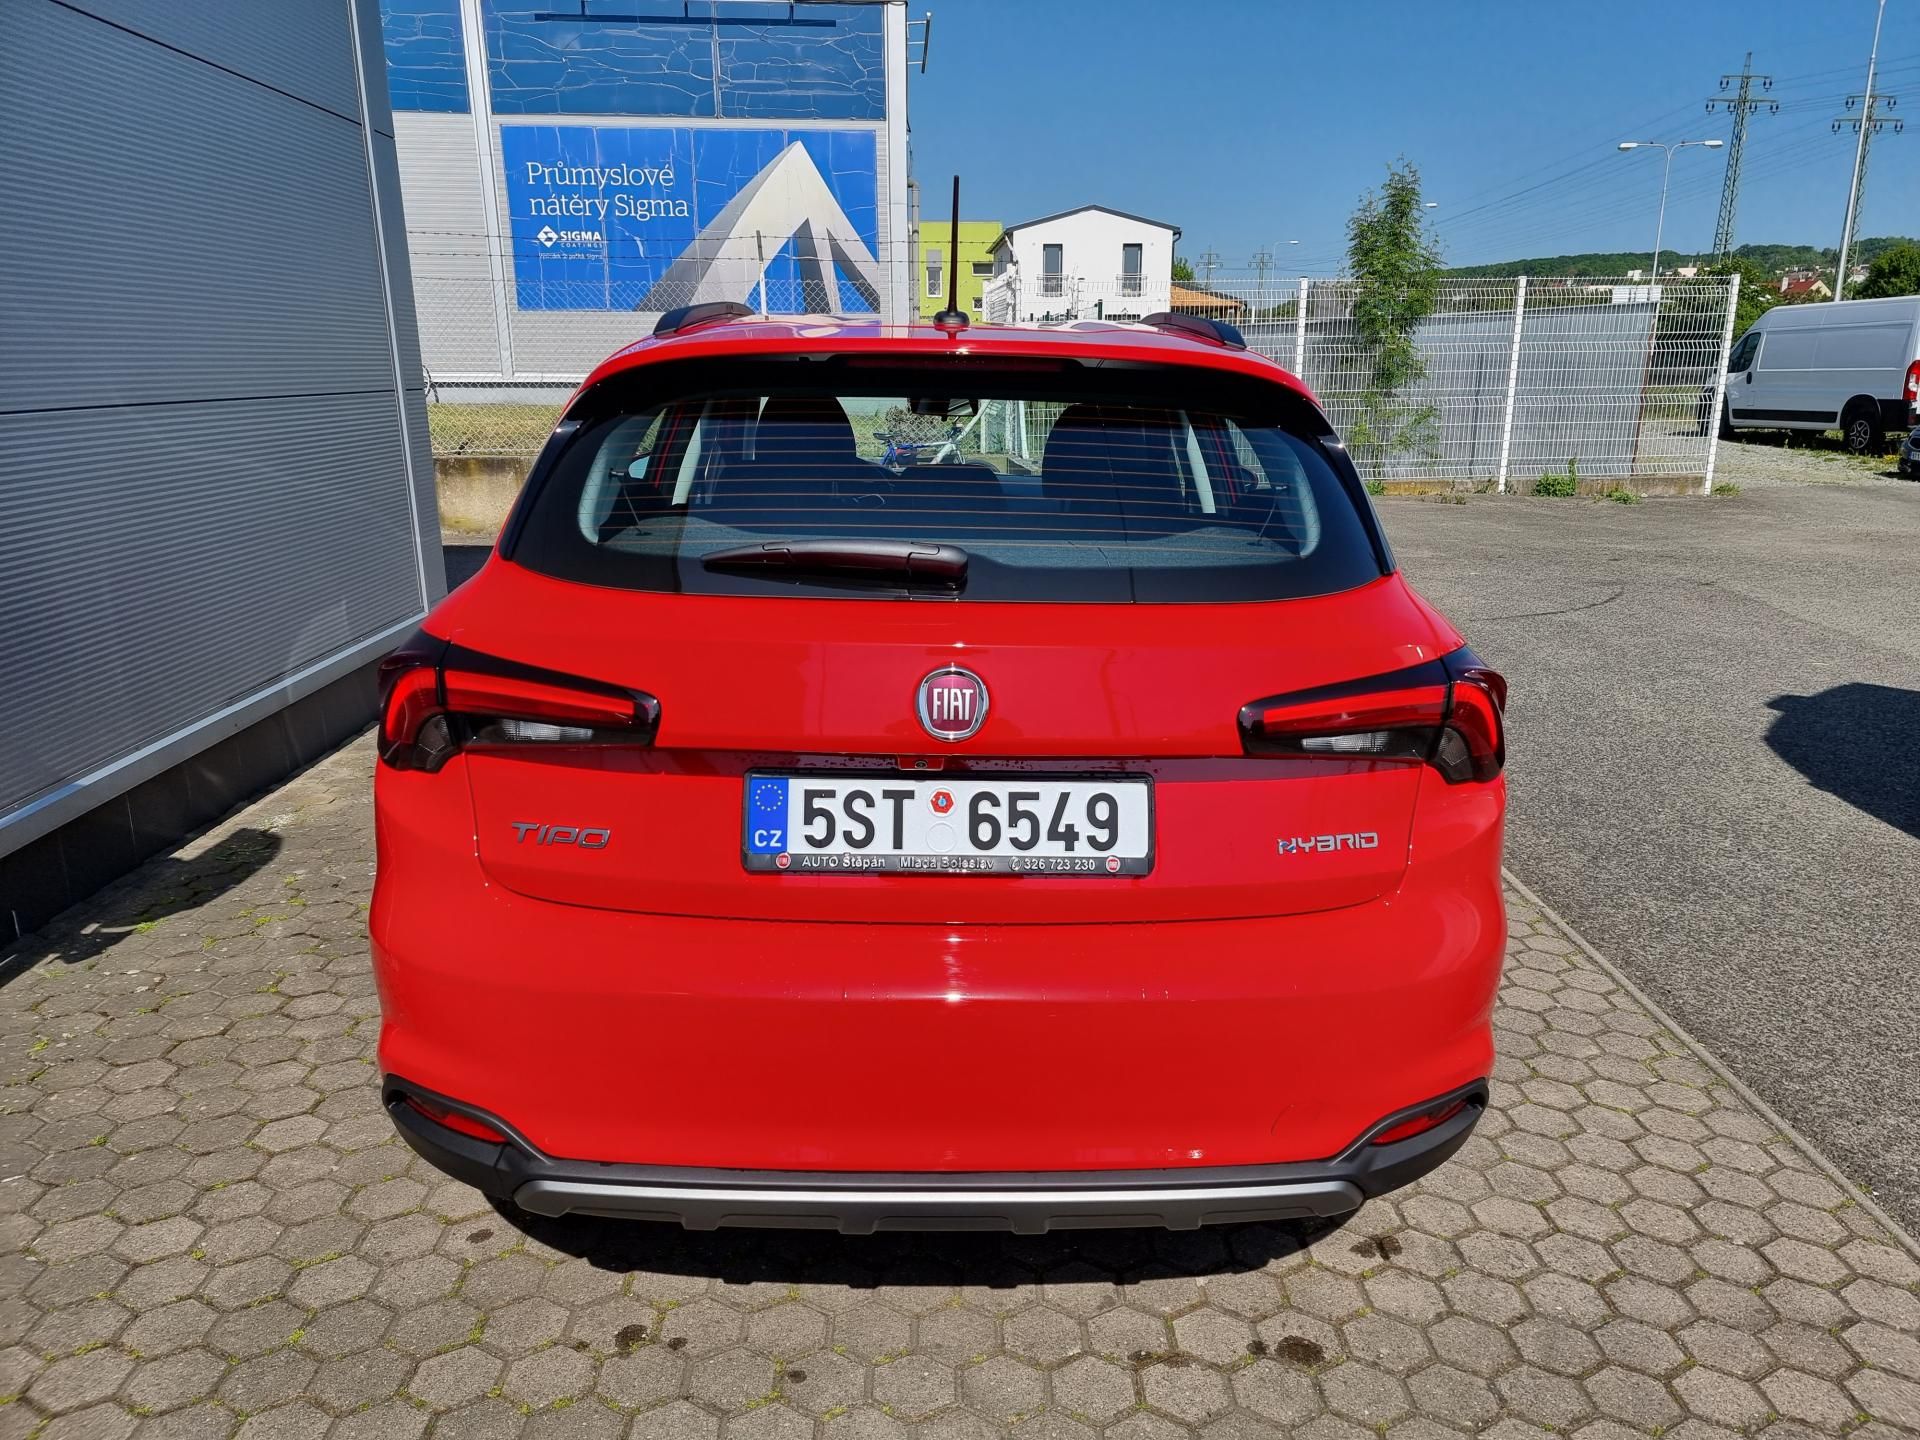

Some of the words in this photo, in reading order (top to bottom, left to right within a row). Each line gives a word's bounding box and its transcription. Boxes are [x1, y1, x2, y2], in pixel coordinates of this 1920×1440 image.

[526, 160, 675, 190] Průmyslové
[529, 193, 609, 221] nátěry
[614, 194, 689, 221] Sigma
[560, 230, 602, 241] SIGMA
[932, 688, 974, 720] FIAT
[802, 788, 915, 850] 5ST
[967, 790, 1119, 852] 6549
[511, 821, 611, 849] TIPO
[754, 829, 782, 847] CZ
[1277, 832, 1379, 855] HYBRID
[802, 855, 839, 867] AUTO
[842, 853, 886, 869] Štěpán
[900, 855, 937, 869] Mladá
[941, 856, 995, 870] Boleslav
[1023, 857, 1046, 869] 326
[1049, 858, 1071, 870] 723
[1075, 858, 1096, 871] 230
